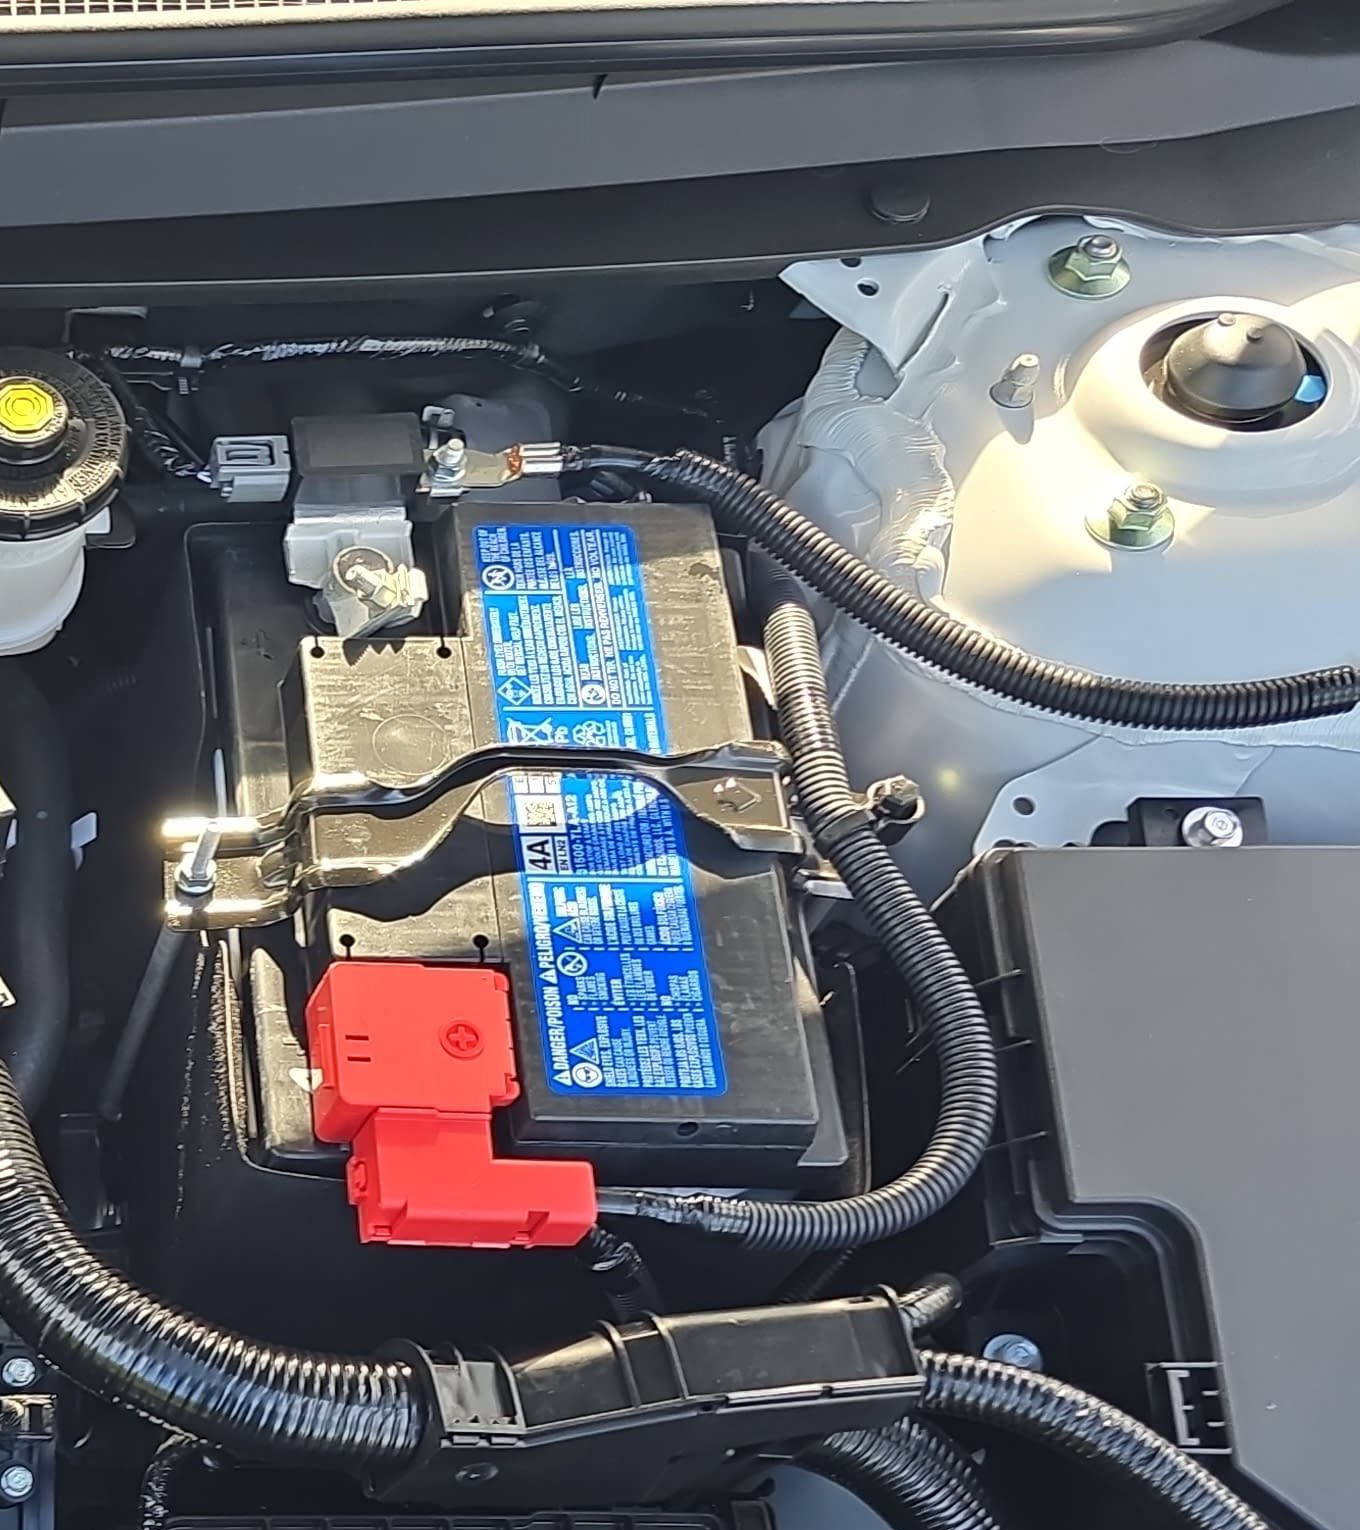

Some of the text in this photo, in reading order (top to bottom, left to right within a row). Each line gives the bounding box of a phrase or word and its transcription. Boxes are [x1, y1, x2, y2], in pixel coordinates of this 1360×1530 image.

[525, 839, 553, 869] 4A
[556, 839, 569, 869] EN LN2
